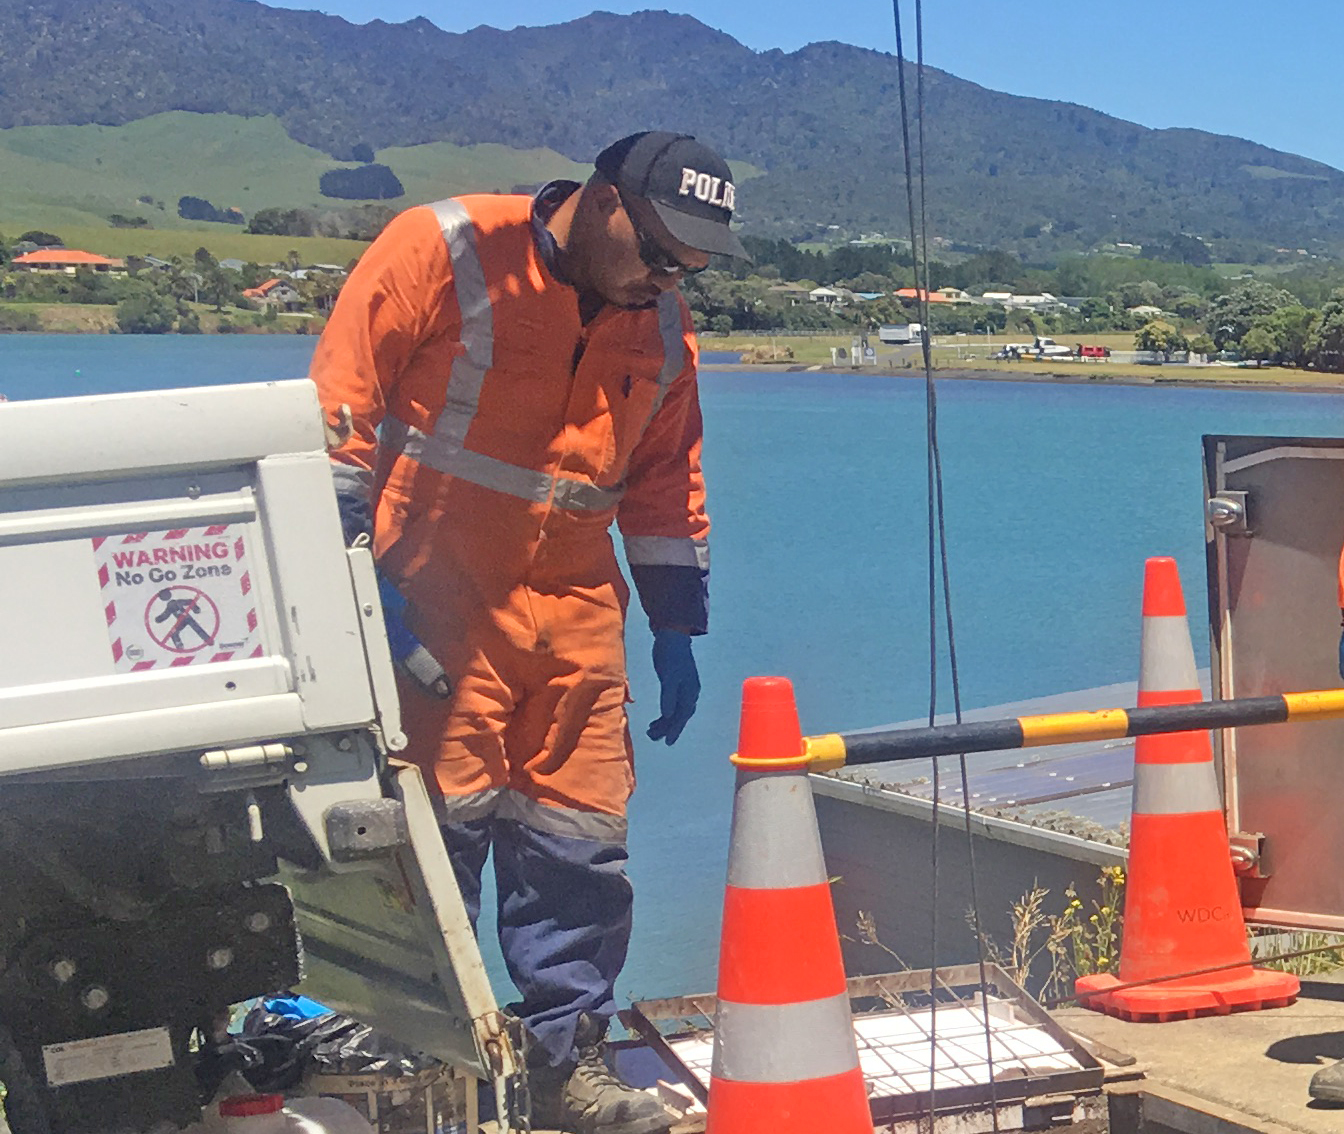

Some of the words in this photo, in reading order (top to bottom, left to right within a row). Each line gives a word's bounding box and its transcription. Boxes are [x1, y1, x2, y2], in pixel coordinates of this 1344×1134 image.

[112, 541, 229, 569] WARNING
[115, 571, 144, 586] No
[148, 567, 177, 583] Go
[180, 563, 232, 580] Zone
